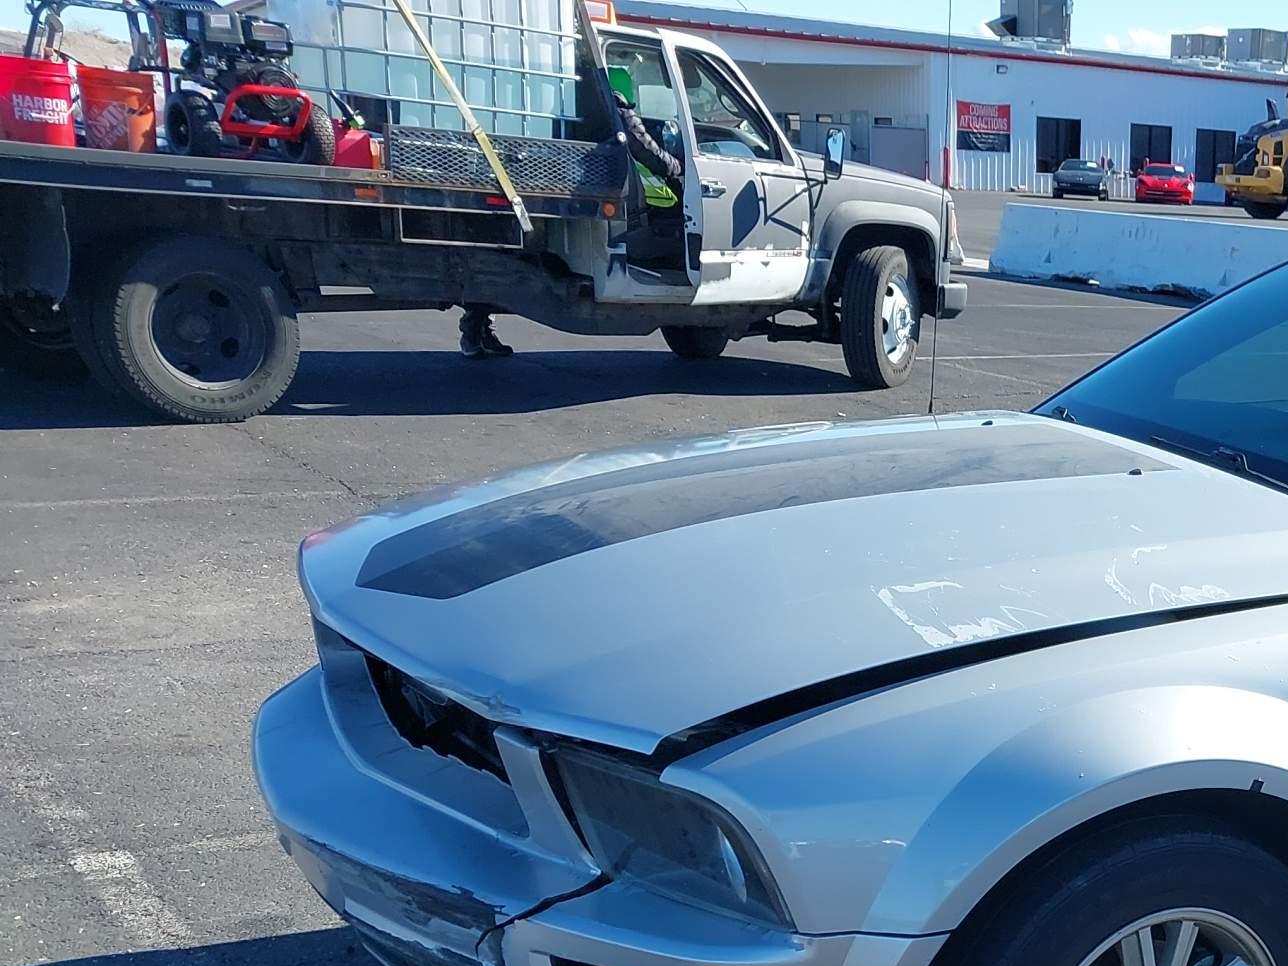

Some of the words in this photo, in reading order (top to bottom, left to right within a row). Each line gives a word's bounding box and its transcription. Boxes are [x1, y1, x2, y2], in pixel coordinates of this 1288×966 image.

[12, 94, 68, 111] HARBOR
[969, 104, 998, 117] COMING
[15, 107, 68, 125] FREIGHT
[960, 115, 1008, 130] ATTRACTIONS
